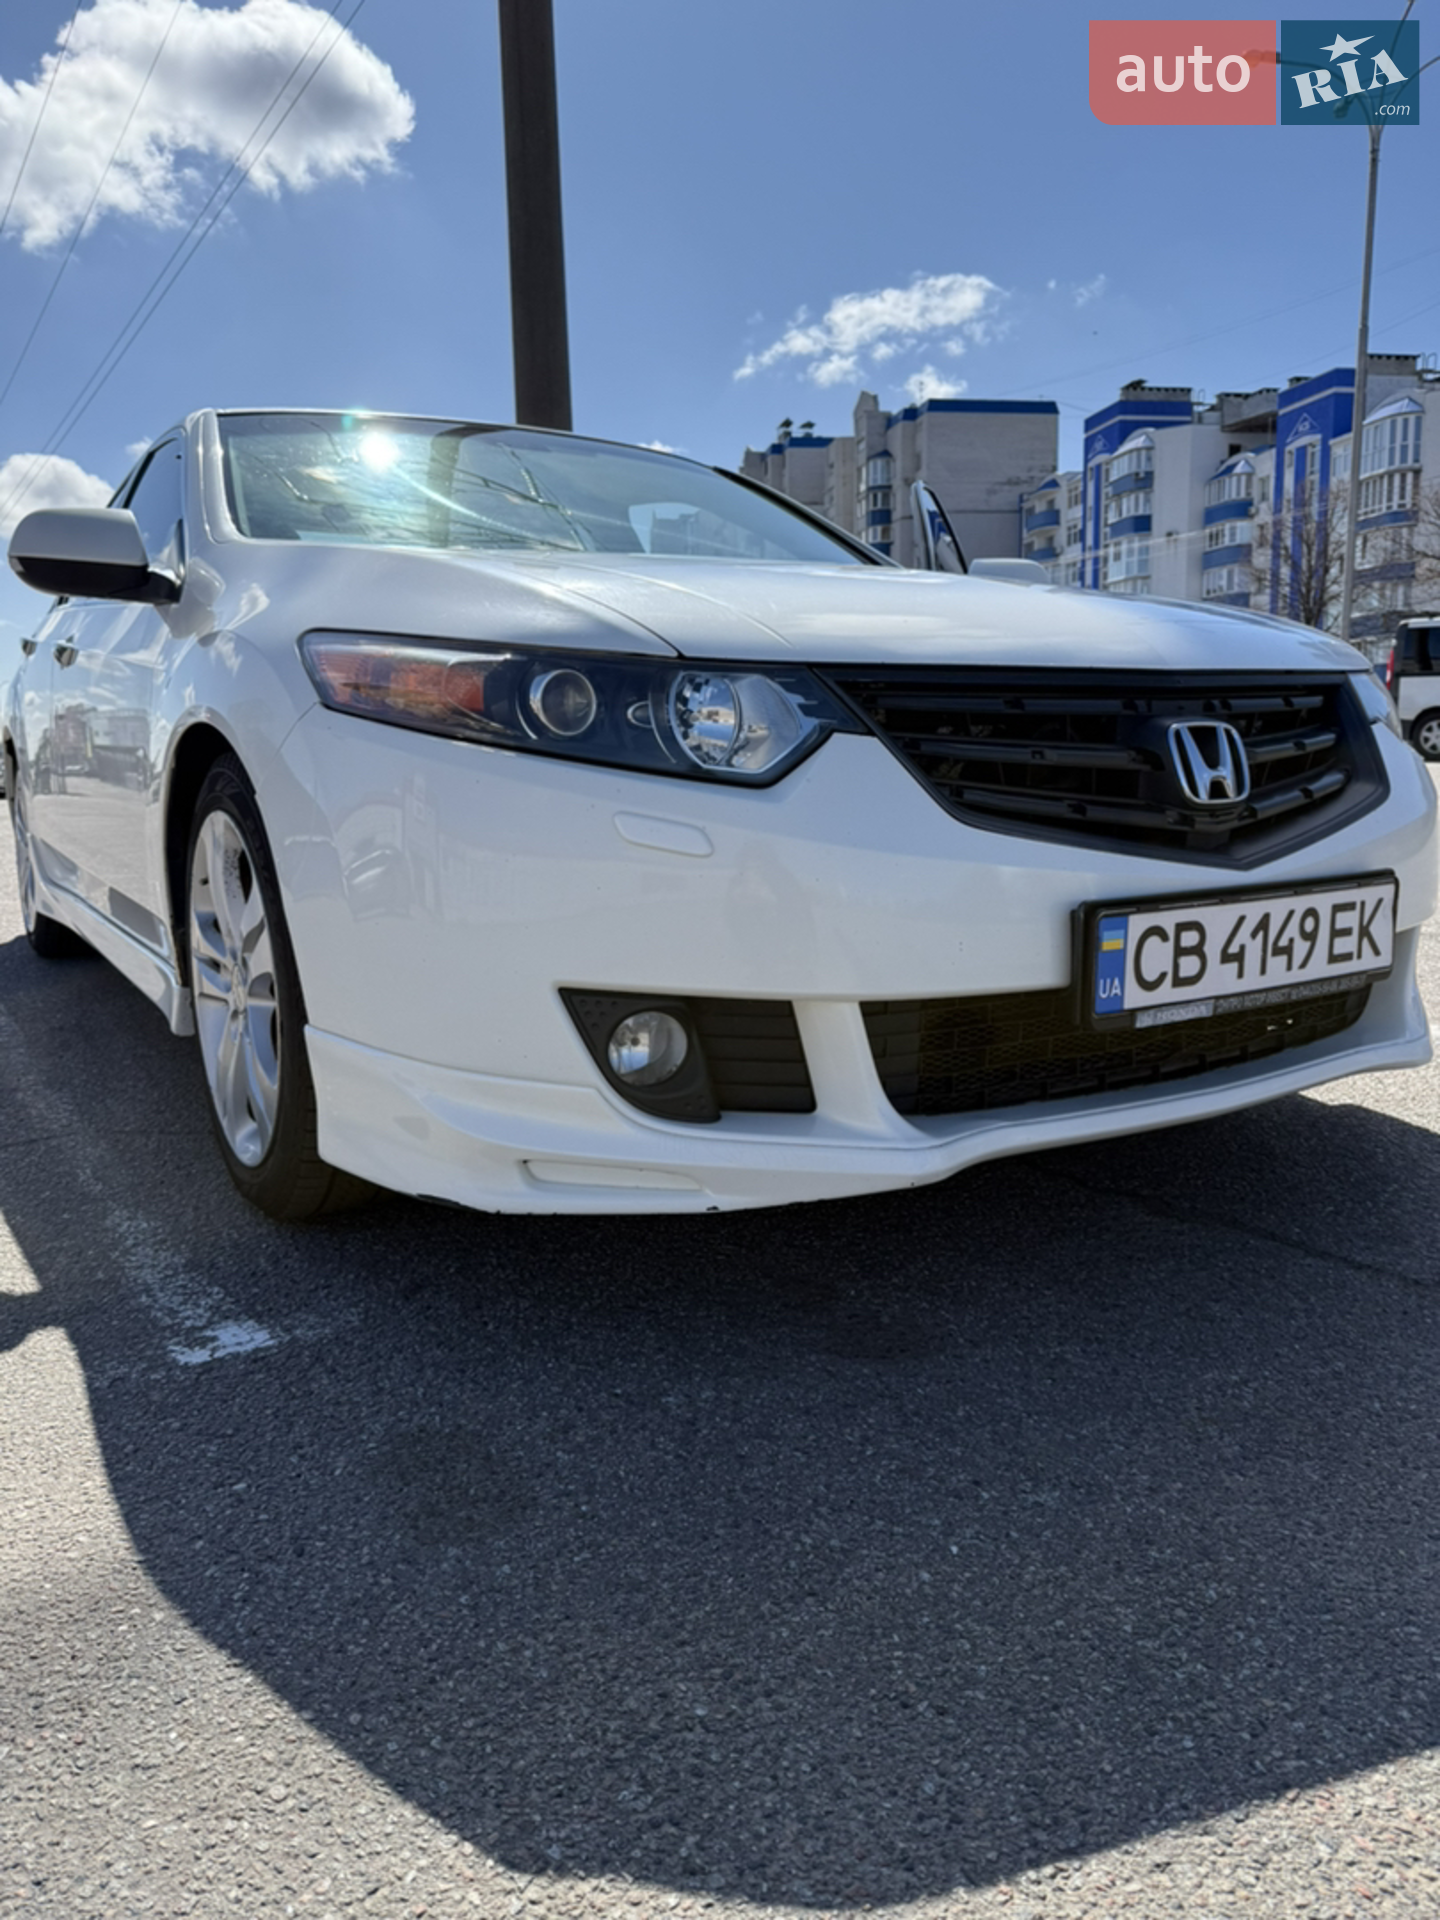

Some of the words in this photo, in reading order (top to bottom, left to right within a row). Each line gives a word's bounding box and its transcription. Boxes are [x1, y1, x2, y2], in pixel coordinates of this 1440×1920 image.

[1133, 920, 1208, 992] CB
[1219, 906, 1321, 980] 4149
[1326, 897, 1385, 965] EK
[1099, 976, 1122, 998] UA
[1155, 1002, 1208, 1021] HONDA
